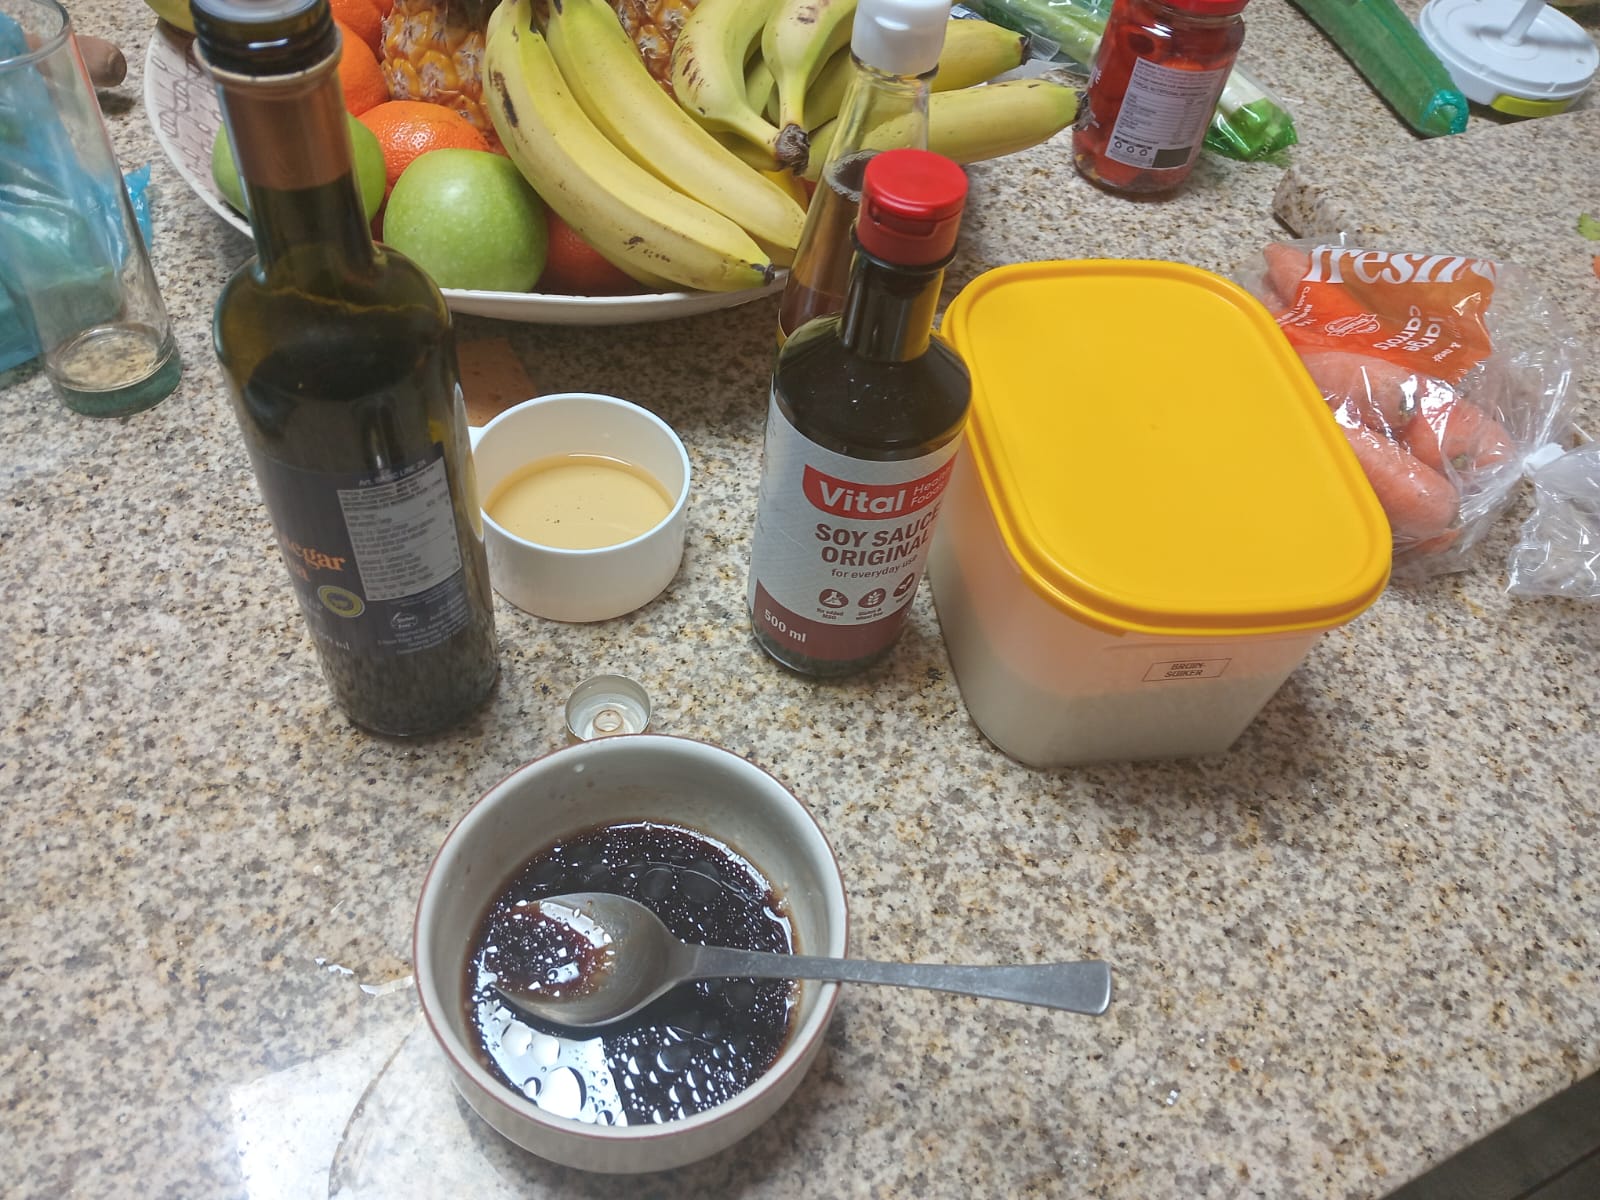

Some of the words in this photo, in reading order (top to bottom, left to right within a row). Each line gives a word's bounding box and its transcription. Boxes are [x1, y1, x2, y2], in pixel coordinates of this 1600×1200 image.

[1372, 304, 1422, 351] carrots
[818, 480, 906, 514] Vital
[815, 523, 869, 547] SOY
[871, 503, 942, 547] SAUCE
[821, 530, 929, 567] ORIGINAL
[831, 568, 849, 578] for
[851, 564, 900, 579] everyday
[764, 608, 786, 633] 500
[789, 629, 807, 643] ml
